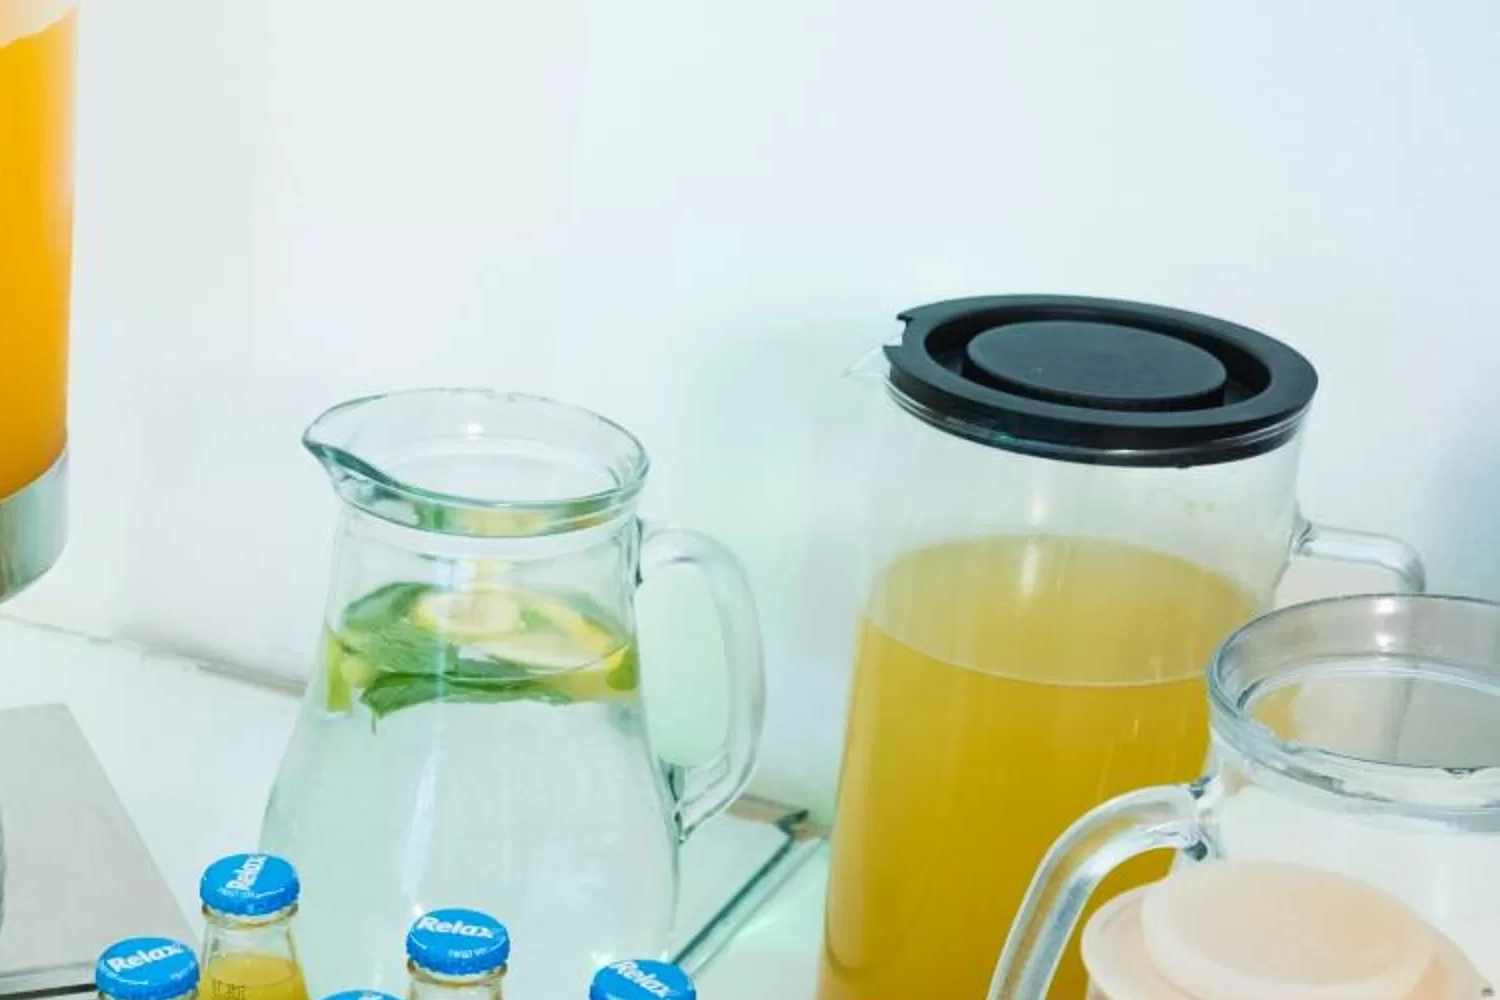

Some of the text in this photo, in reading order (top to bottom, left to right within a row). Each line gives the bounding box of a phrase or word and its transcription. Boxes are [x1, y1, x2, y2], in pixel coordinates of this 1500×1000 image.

[416, 916, 497, 939] Relax
[108, 942, 184, 973] Relax
[609, 960, 671, 999] Relax
